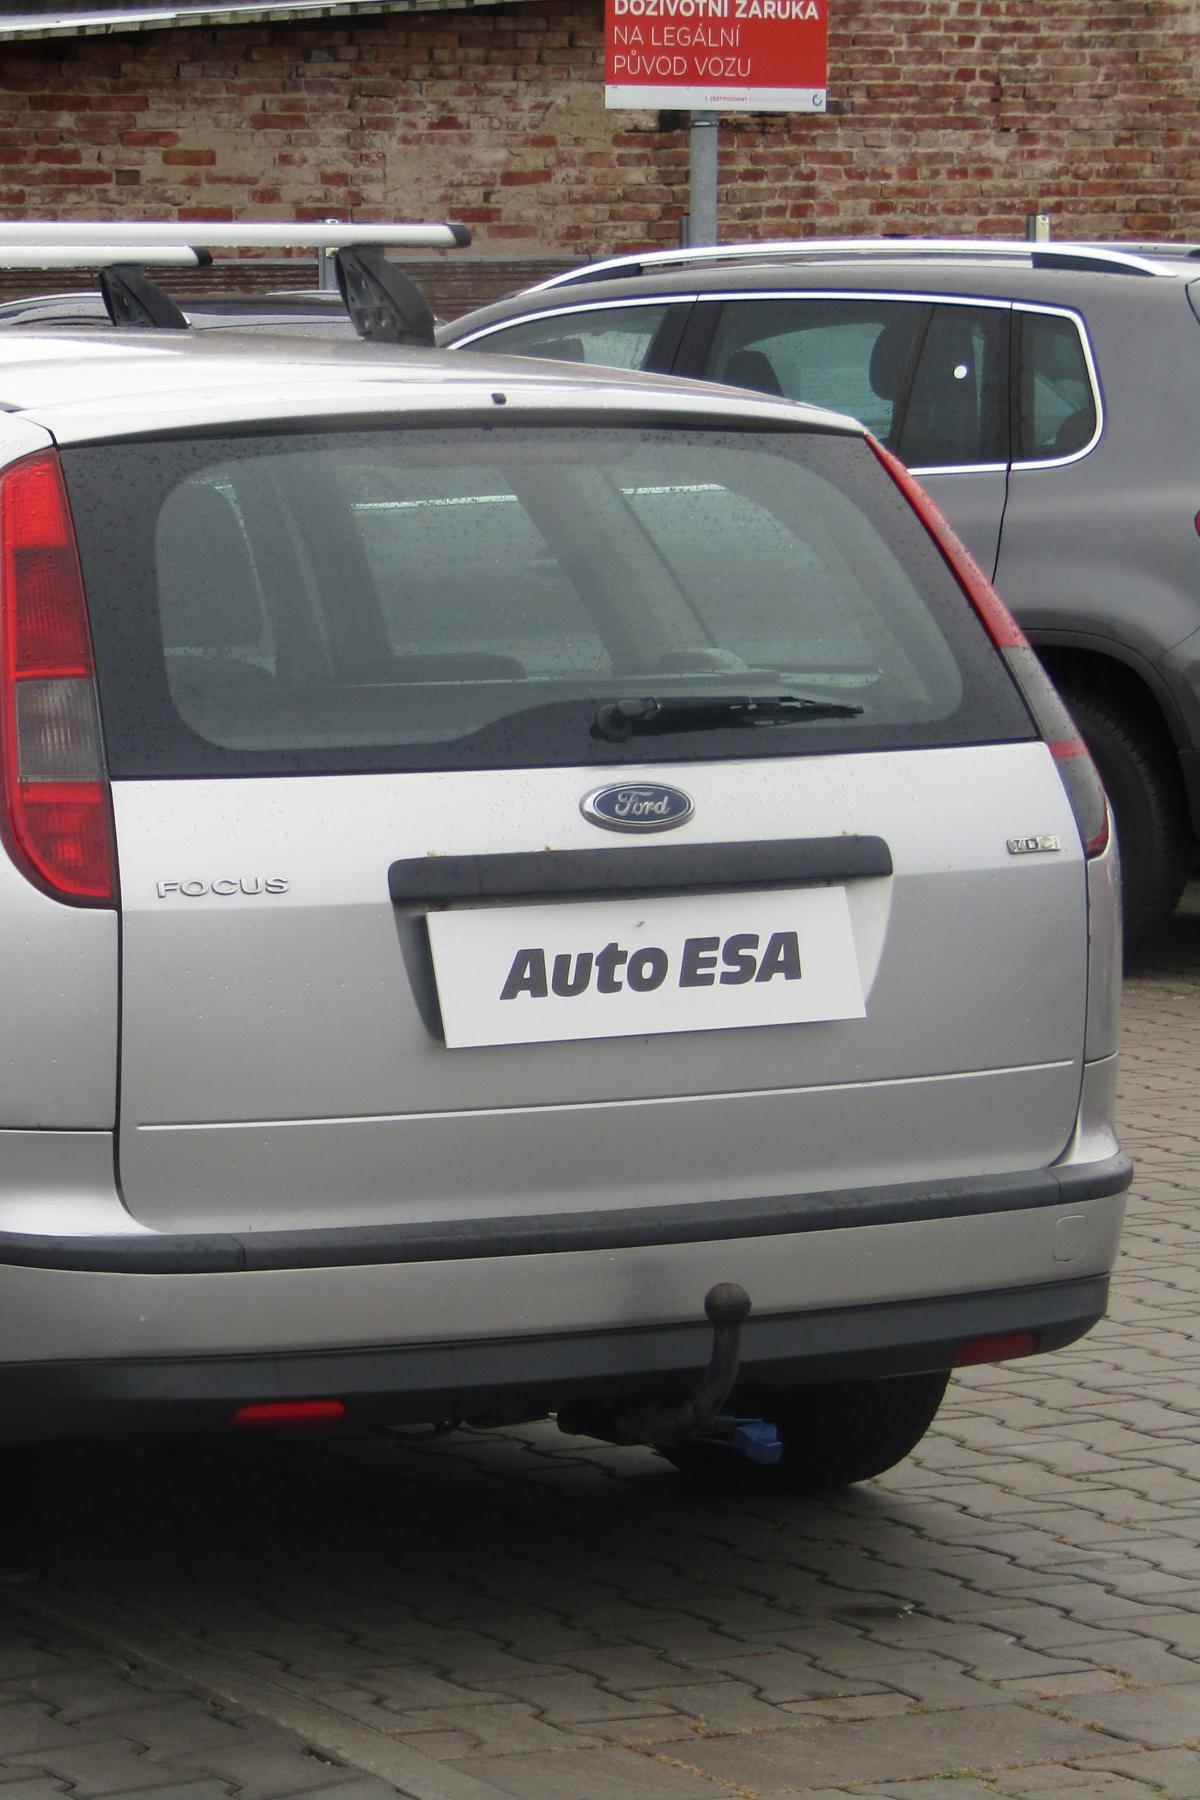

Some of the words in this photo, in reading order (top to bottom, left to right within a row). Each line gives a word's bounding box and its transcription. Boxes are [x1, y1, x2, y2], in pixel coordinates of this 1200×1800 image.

[614, 25, 644, 45] NA
[651, 23, 741, 47] LEGÁLNÍ
[614, 50, 687, 76] PŮVOD
[694, 57, 751, 77] VOZU
[614, 790, 671, 816] Ford
[156, 876, 290, 899] FOCUS
[499, 942, 669, 1001] Auto
[679, 931, 802, 988] ESA
